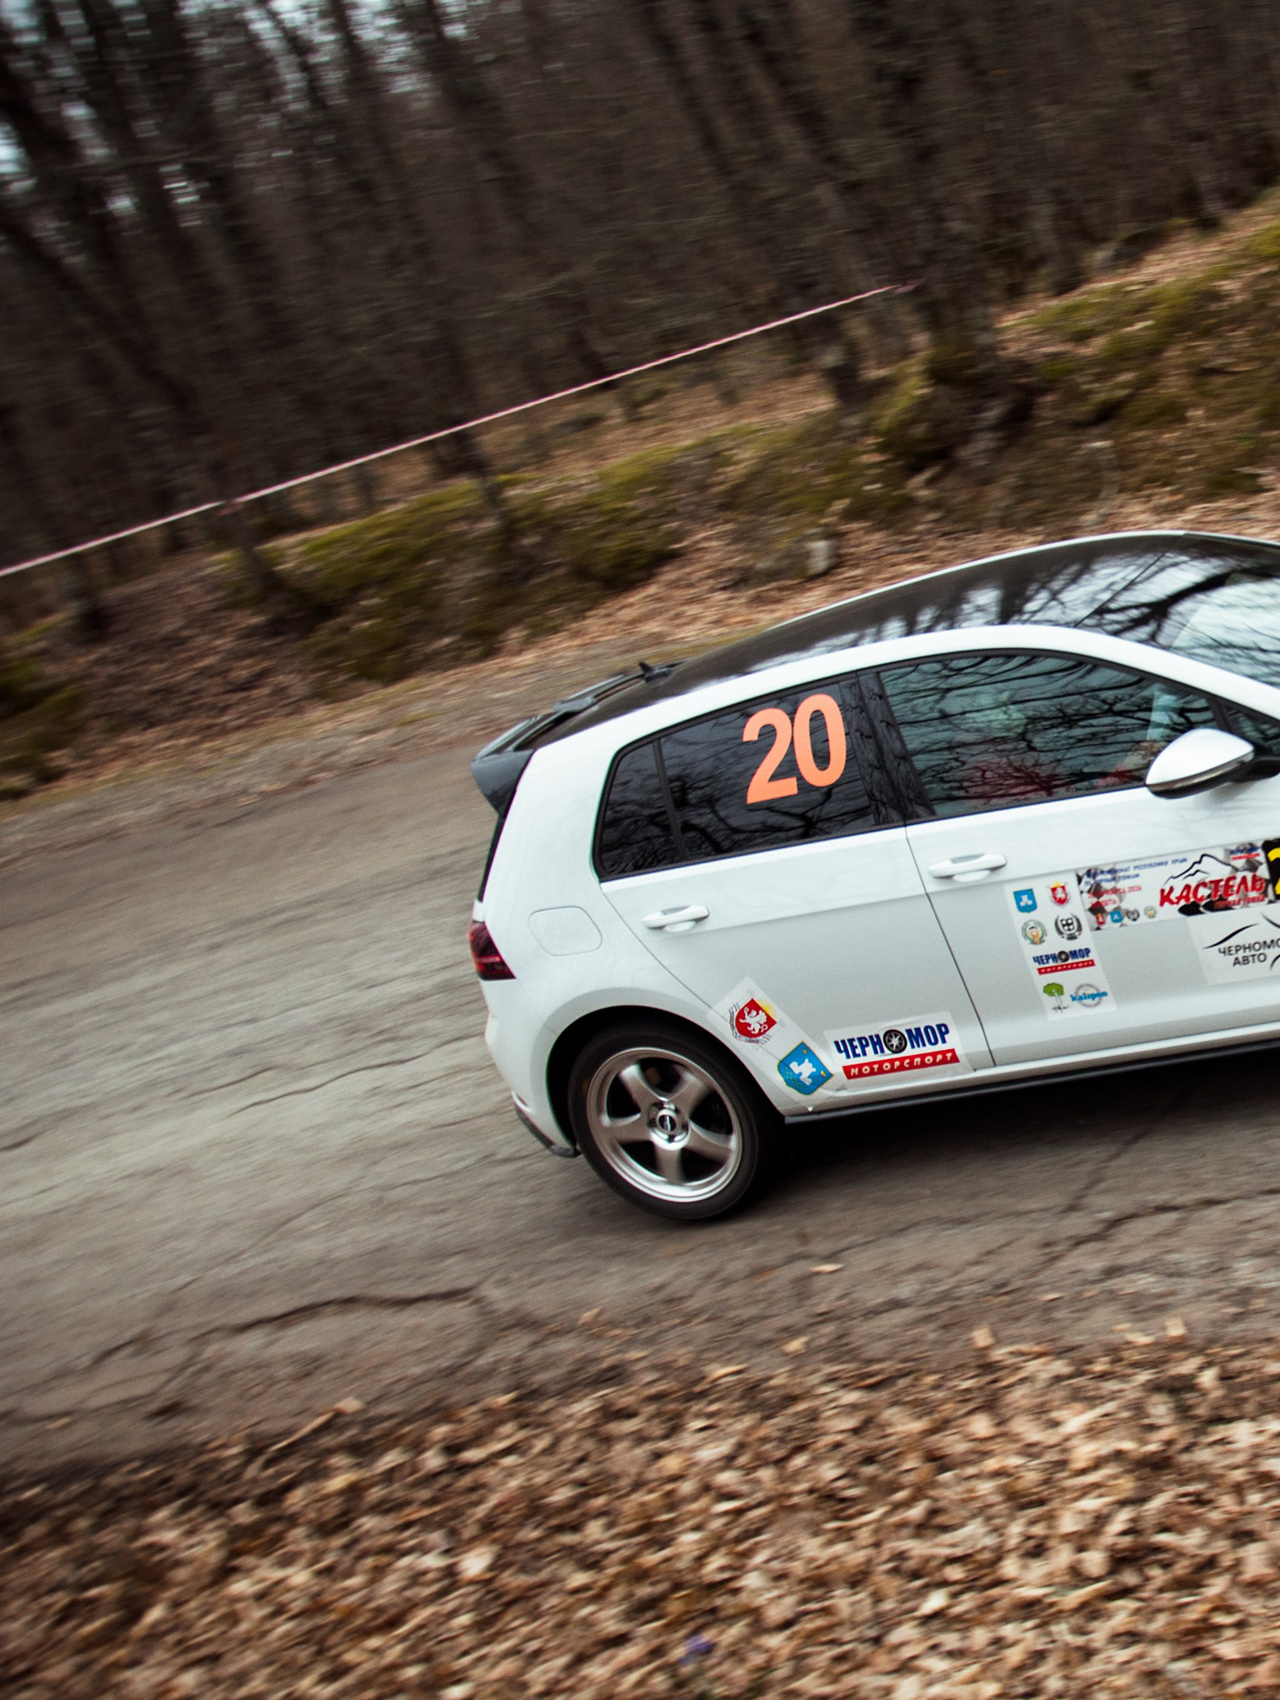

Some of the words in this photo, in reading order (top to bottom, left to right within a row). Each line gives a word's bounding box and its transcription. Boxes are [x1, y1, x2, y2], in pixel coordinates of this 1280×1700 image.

[742, 693, 847, 805] 20
[1159, 872, 1267, 907] КАСТЕЛЬ
[1032, 947, 1092, 966] ЧЕРНОМОР
[1232, 952, 1268, 967] АВТО
[833, 1023, 951, 1060] ЧЕРНОМОР
[850, 1052, 954, 1077] МОТОРСПОРТ
